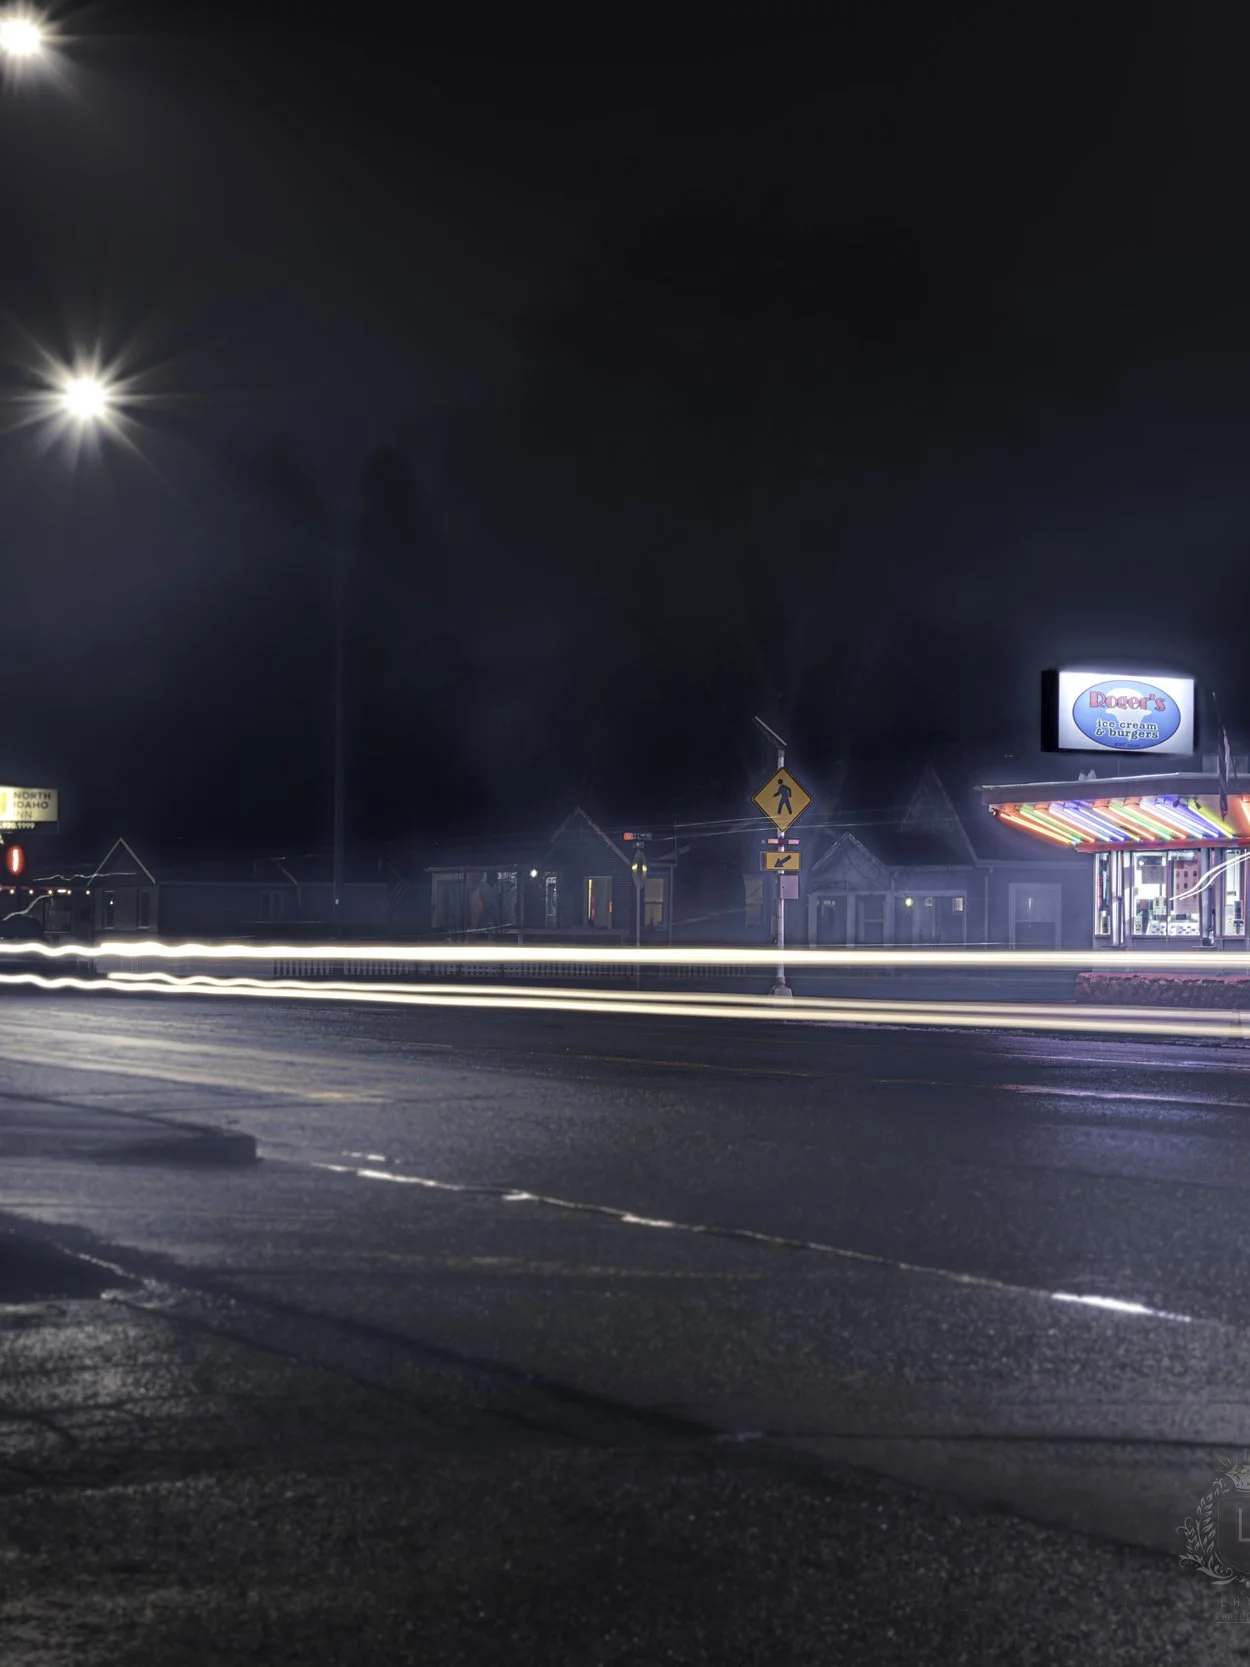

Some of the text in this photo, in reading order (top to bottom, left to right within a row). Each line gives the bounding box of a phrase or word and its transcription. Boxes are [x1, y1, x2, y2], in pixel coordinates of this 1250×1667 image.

[1090, 691, 1166, 712] Roger's
[1098, 718, 1157, 730] ice cream
[1110, 728, 1158, 739] burgers
[13, 801, 49, 809] IDAHO
